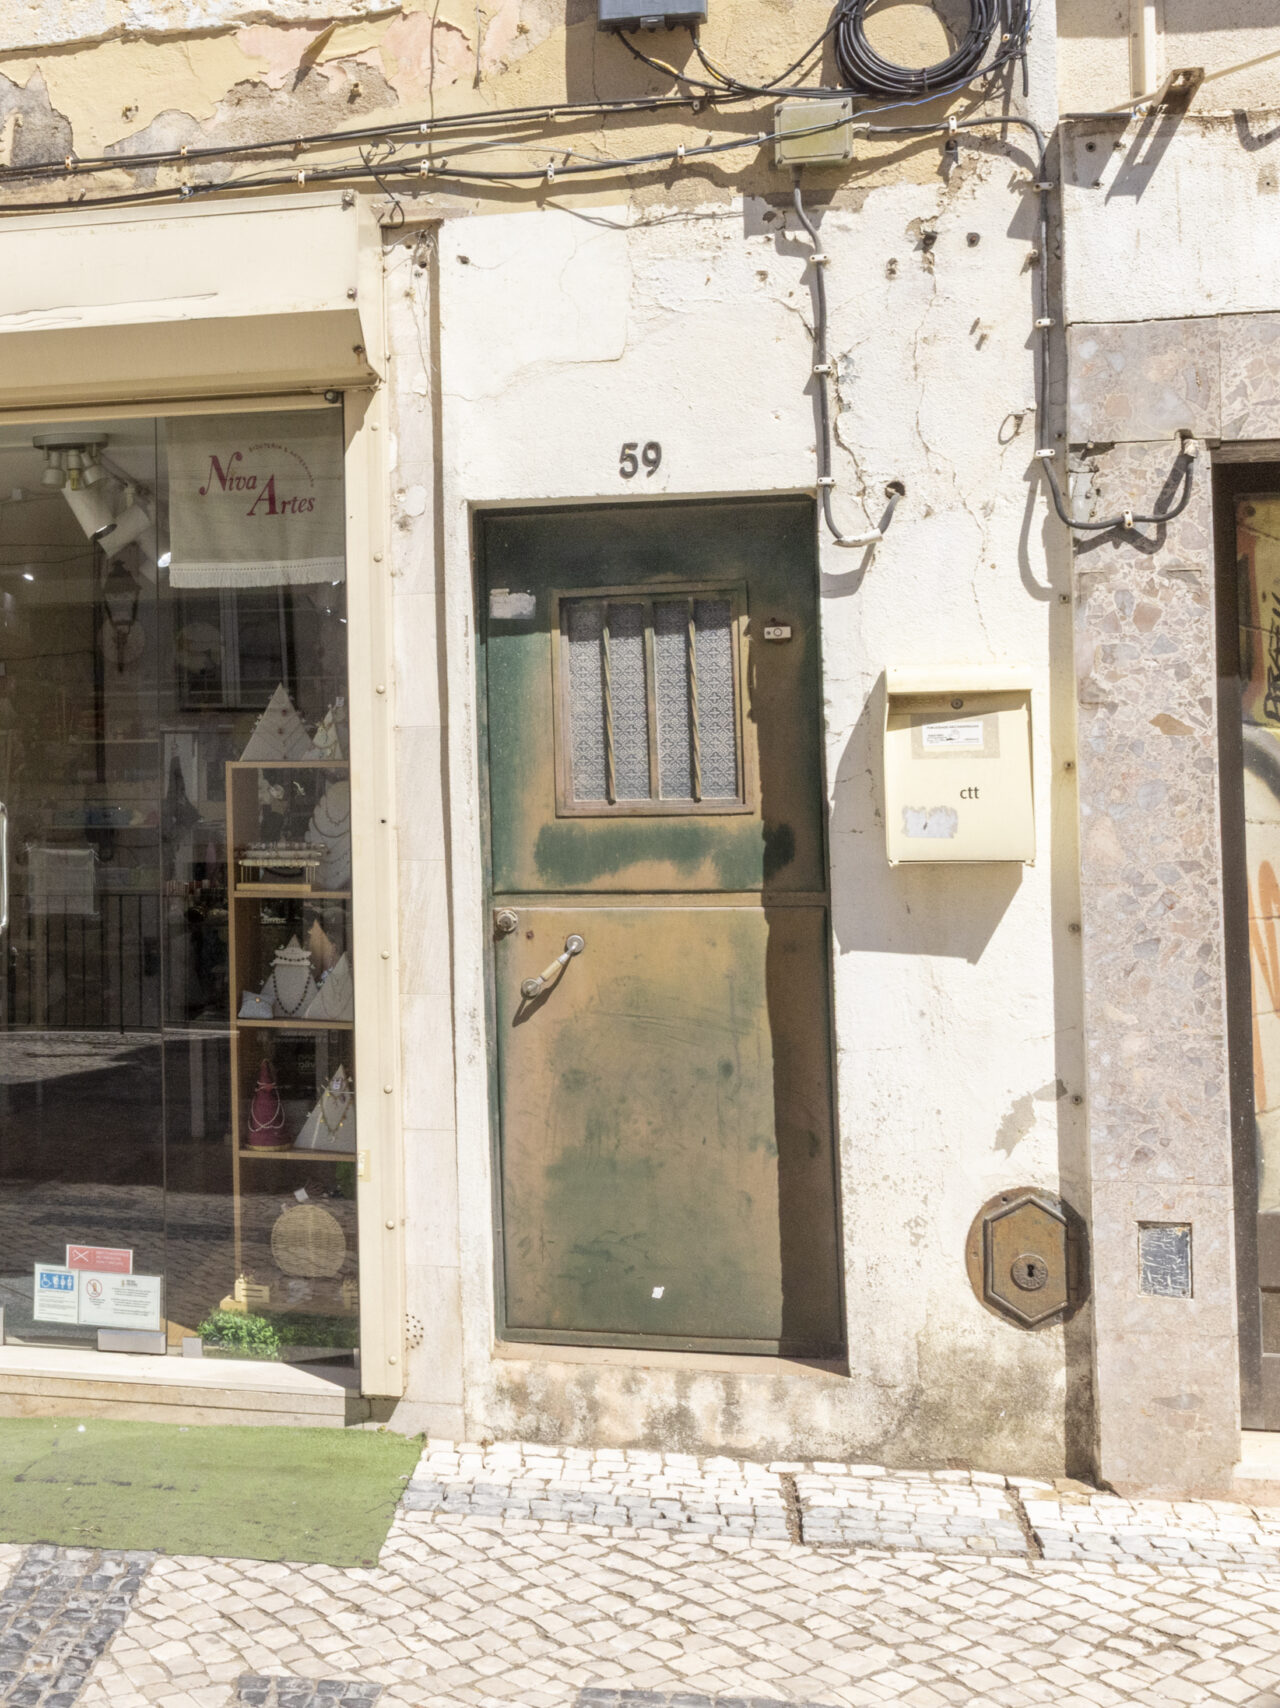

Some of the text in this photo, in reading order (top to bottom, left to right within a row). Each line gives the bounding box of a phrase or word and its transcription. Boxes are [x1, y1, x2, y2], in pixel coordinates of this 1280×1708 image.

[198, 451, 258, 496] Niva
[619, 441, 662, 479] 59
[246, 473, 316, 516] Artes
[959, 786, 980, 800] ctt
